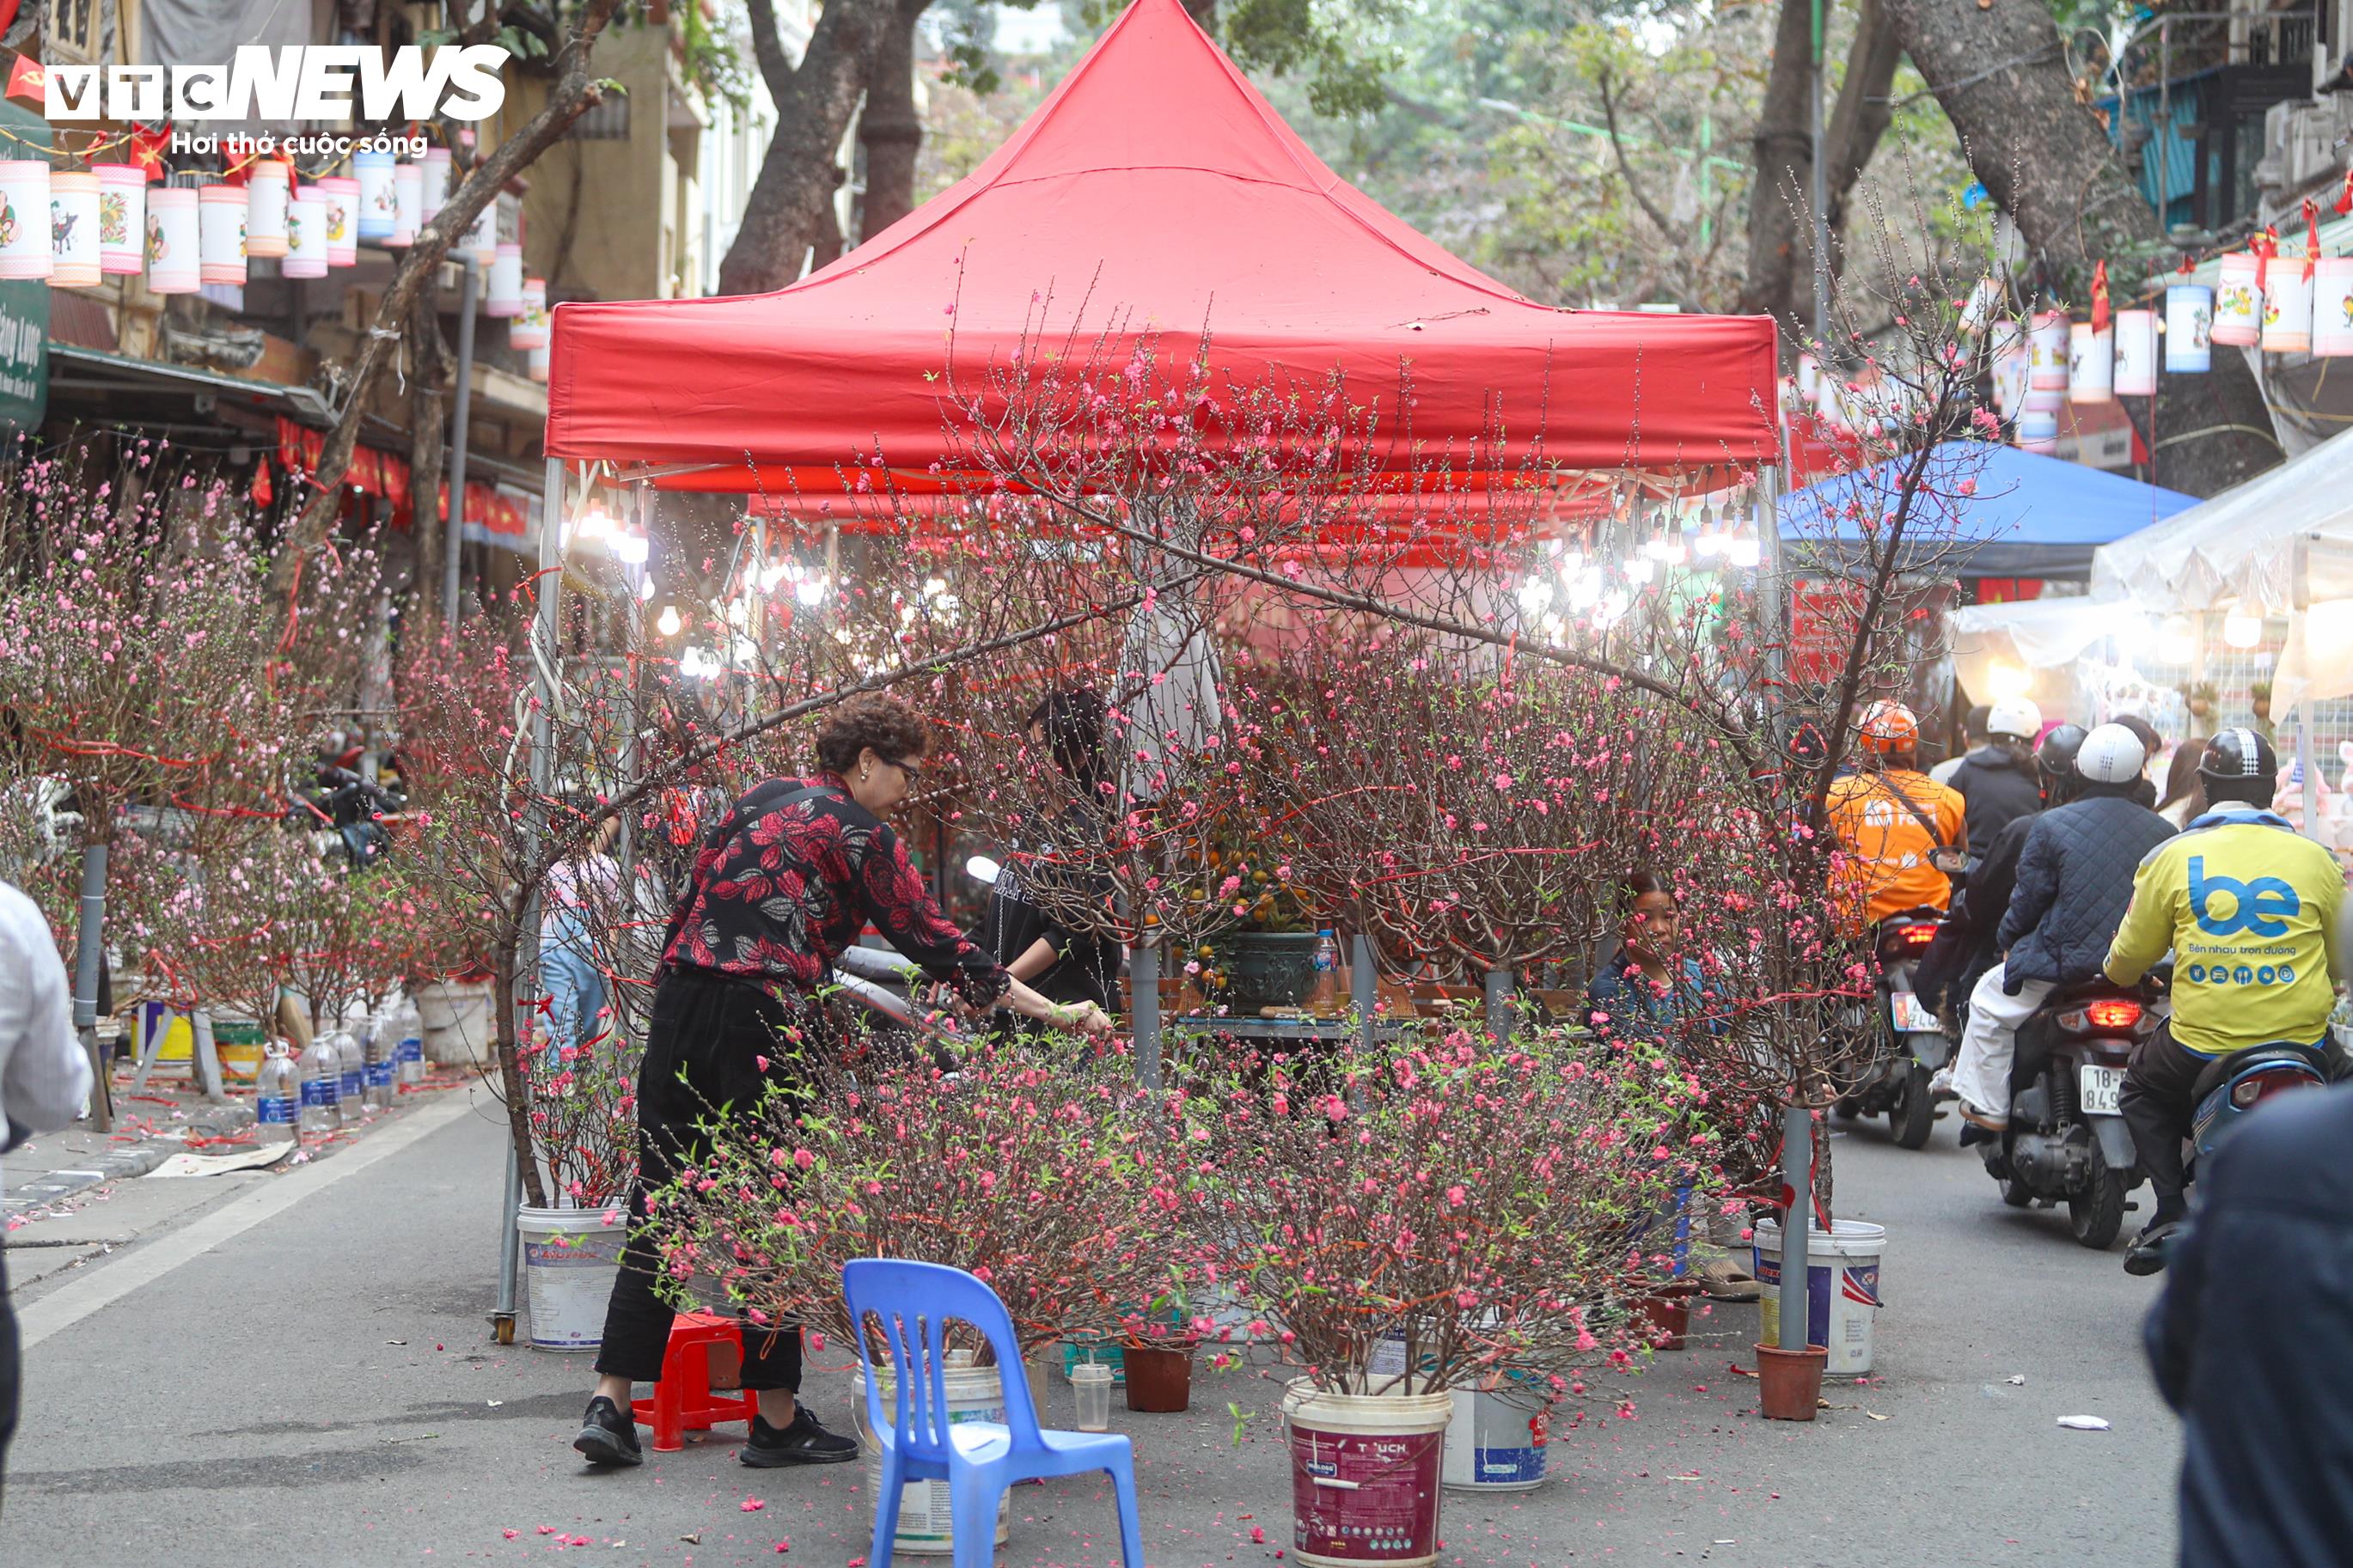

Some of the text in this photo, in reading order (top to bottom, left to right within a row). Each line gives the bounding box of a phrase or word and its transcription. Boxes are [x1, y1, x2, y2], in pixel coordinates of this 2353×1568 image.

[2188, 855, 2301, 937] be
[2188, 943, 2207, 955] Bên
[2209, 944, 2237, 955] nhau
[2264, 945, 2297, 956] đường
